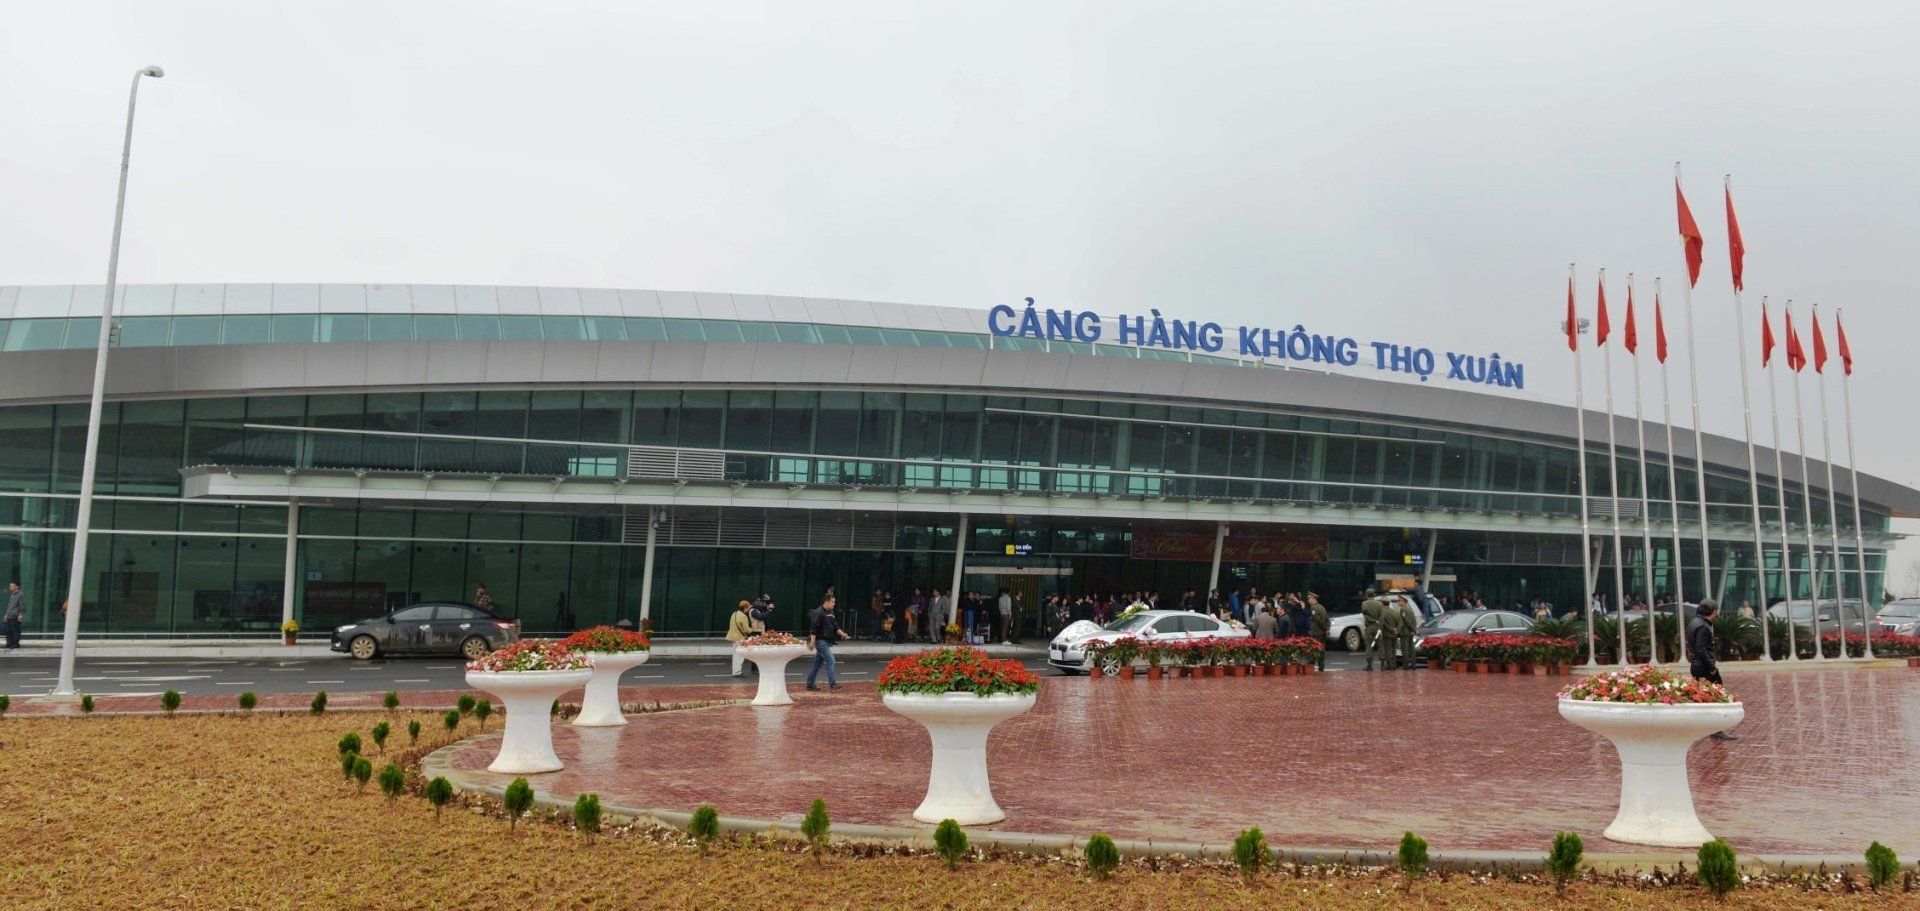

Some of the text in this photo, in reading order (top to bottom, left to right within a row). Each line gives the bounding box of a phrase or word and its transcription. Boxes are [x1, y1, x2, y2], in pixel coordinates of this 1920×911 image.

[987, 297, 1525, 390] CẢNG HÀNG KHÔNG THỌ XUÂN
